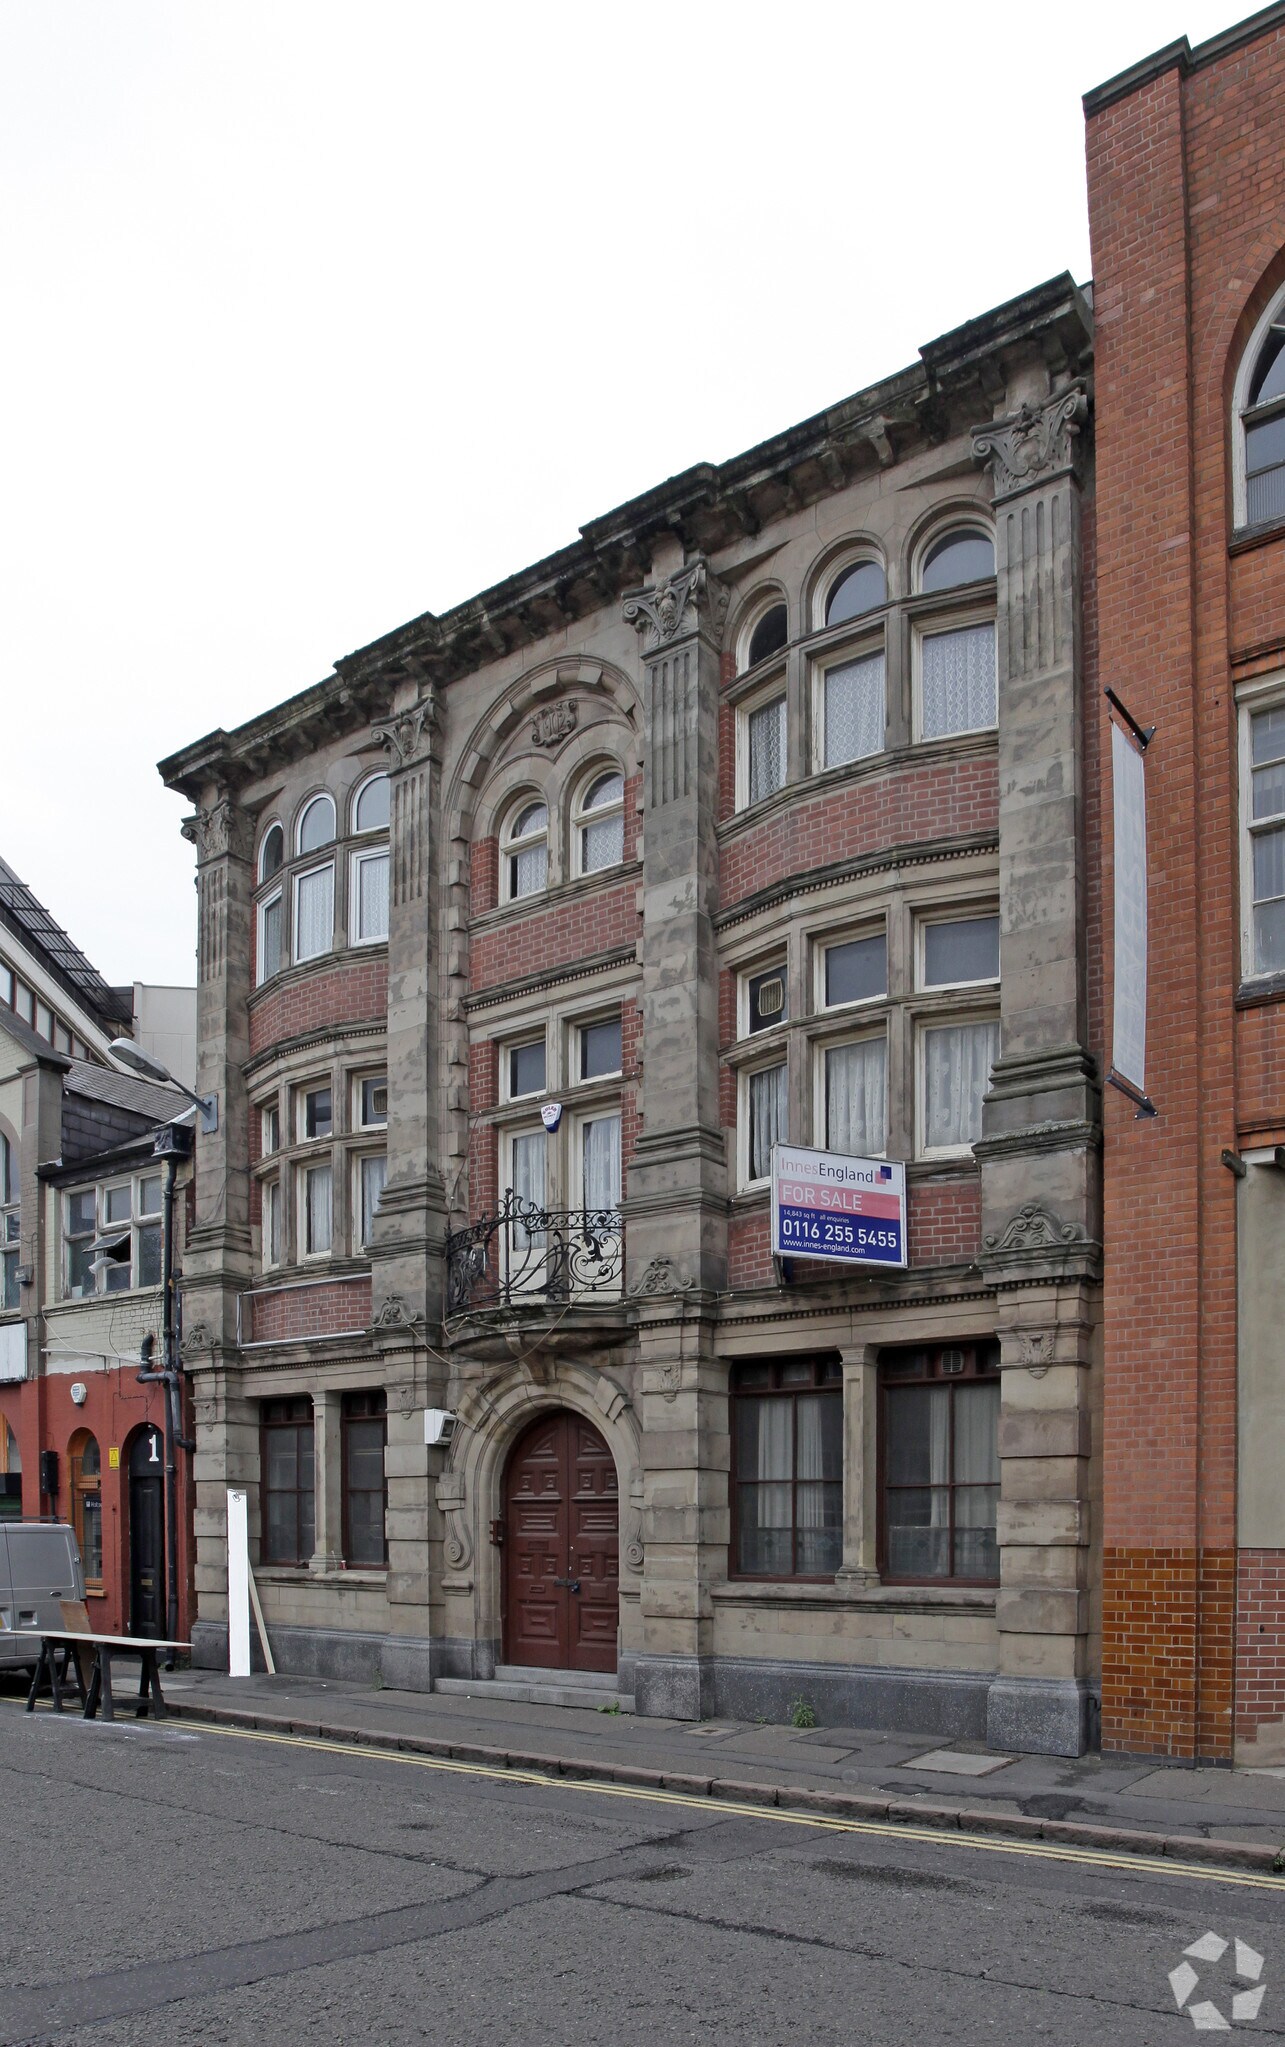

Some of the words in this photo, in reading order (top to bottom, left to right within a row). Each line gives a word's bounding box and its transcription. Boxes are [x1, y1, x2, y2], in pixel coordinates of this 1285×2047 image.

[783, 1184, 816, 1205] FOR
[820, 1189, 863, 1212] SALE
[783, 1209, 803, 1218] 14,843
[826, 1216, 850, 1224] enquiries
[783, 1219, 820, 1239] 0116
[824, 1224, 853, 1243] 255
[858, 1228, 897, 1248] 5455
[783, 1239, 865, 1254] www.innes-england.com
[149, 1434, 159, 1462] 1
